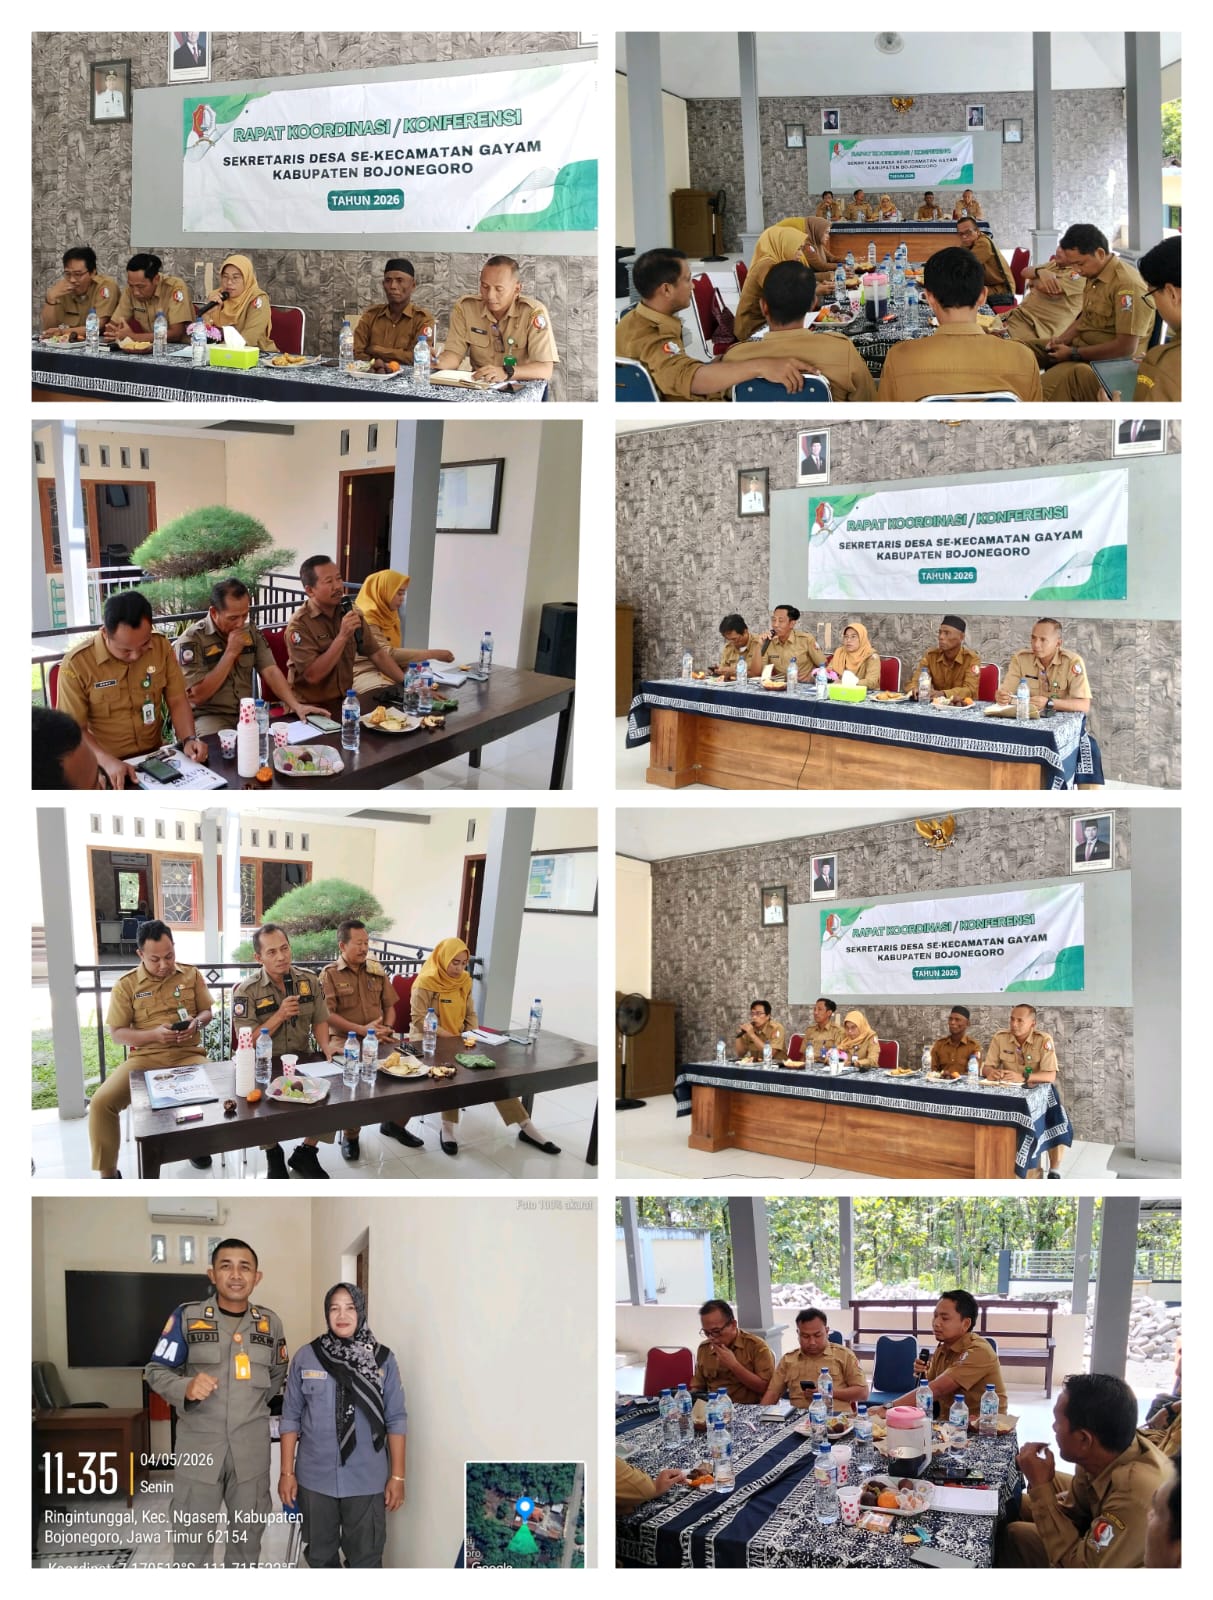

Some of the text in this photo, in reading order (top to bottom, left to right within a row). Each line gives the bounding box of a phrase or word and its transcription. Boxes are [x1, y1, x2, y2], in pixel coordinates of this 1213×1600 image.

[233, 108, 522, 142] RAPAT KOORDINASI / KONFERENSI
[223, 140, 542, 167] SEKRETARIS DESA SE-KECAMATAN GAYAM
[273, 162, 473, 180] KABUPATEN BOJONEGORO
[331, 194, 400, 206] TAHUN 2026
[847, 505, 1069, 531] RAPAT KOORDINASI / KONFERENSI
[839, 530, 1083, 550] SEKRETARIS DESA SE-KECAMATAN GAYAM
[877, 547, 1030, 560] KABUPATEN BOJONEGORO
[921, 571, 974, 581] TAHUN 2026
[852, 913, 1035, 938] RAPAT KOORDINASI / KONFERENSI
[846, 933, 1048, 953] SEKRETARIS DESA SE-KECAMATAN GAYAM
[877, 948, 1005, 962] KABUPATEN BOJONEGORO
[914, 969, 958, 977] TAHUN 2026
[190, 1334, 215, 1342] BUDI
